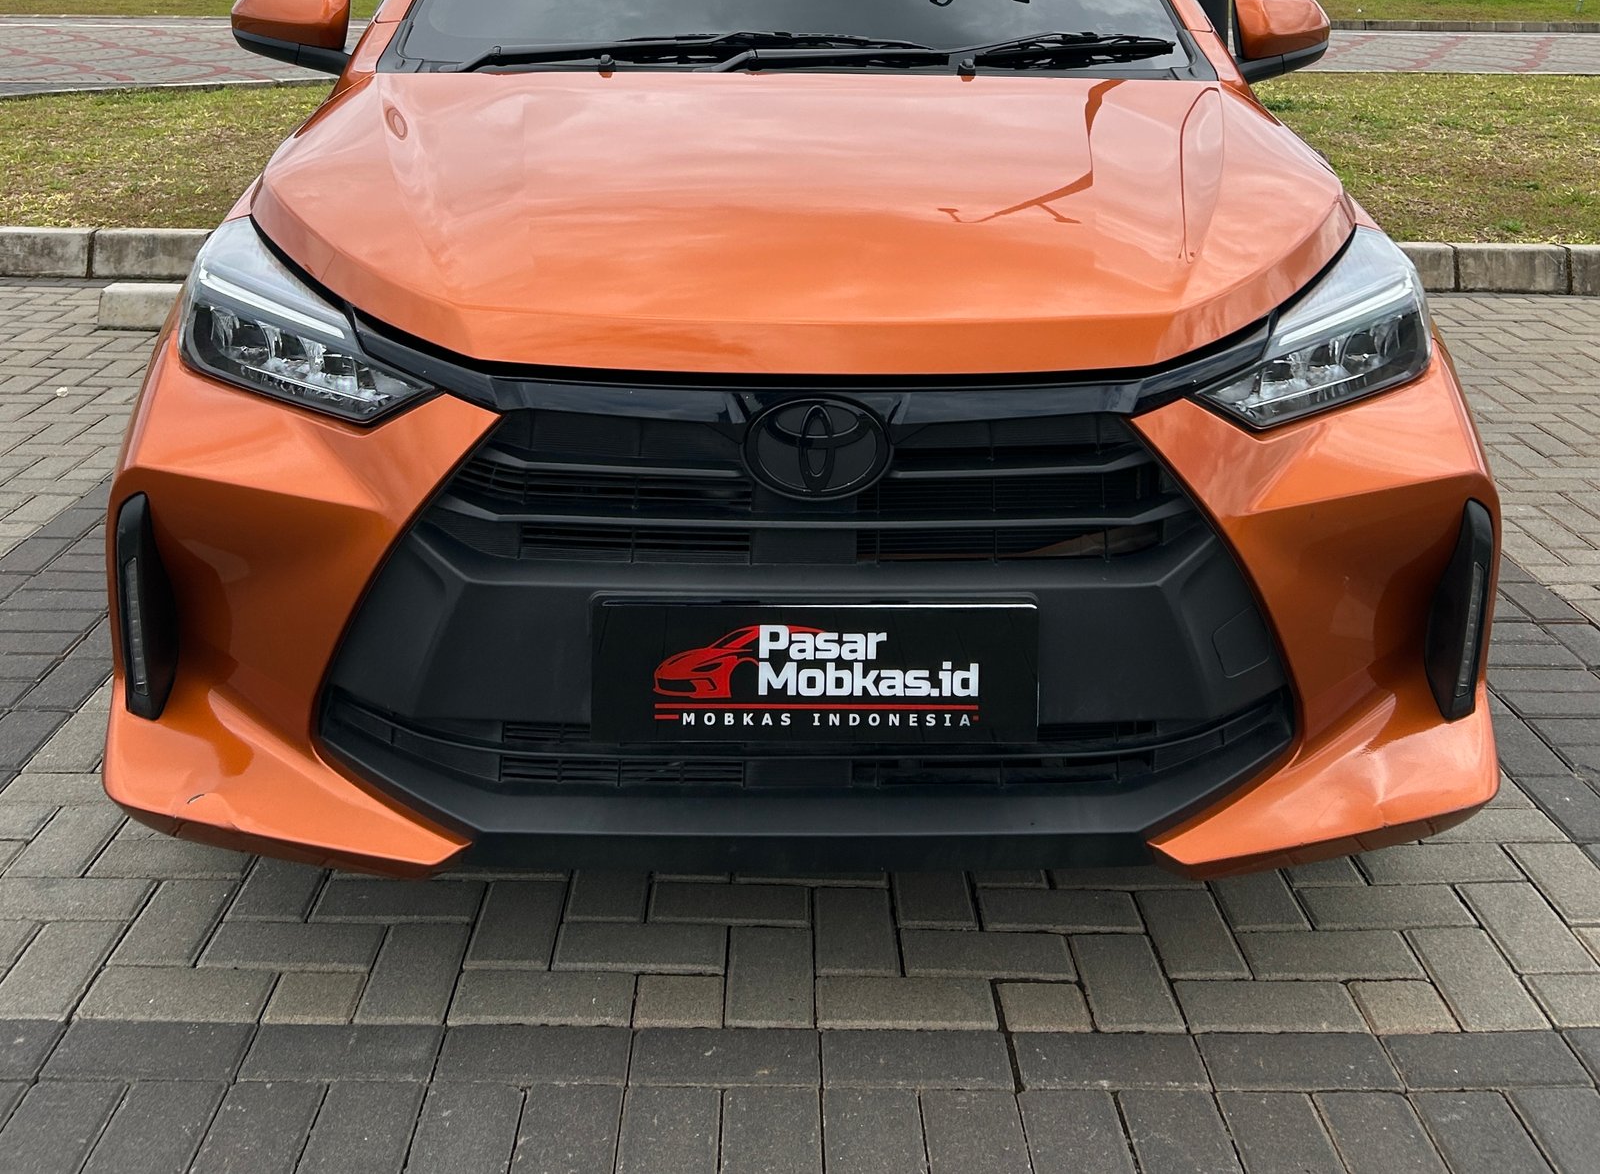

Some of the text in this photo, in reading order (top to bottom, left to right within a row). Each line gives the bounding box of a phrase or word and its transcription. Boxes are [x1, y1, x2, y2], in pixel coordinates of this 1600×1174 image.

[758, 624, 888, 661] Pasar
[758, 661, 979, 698] Mobkas.id
[682, 712, 972, 727] MOBKAS INDONESIA
